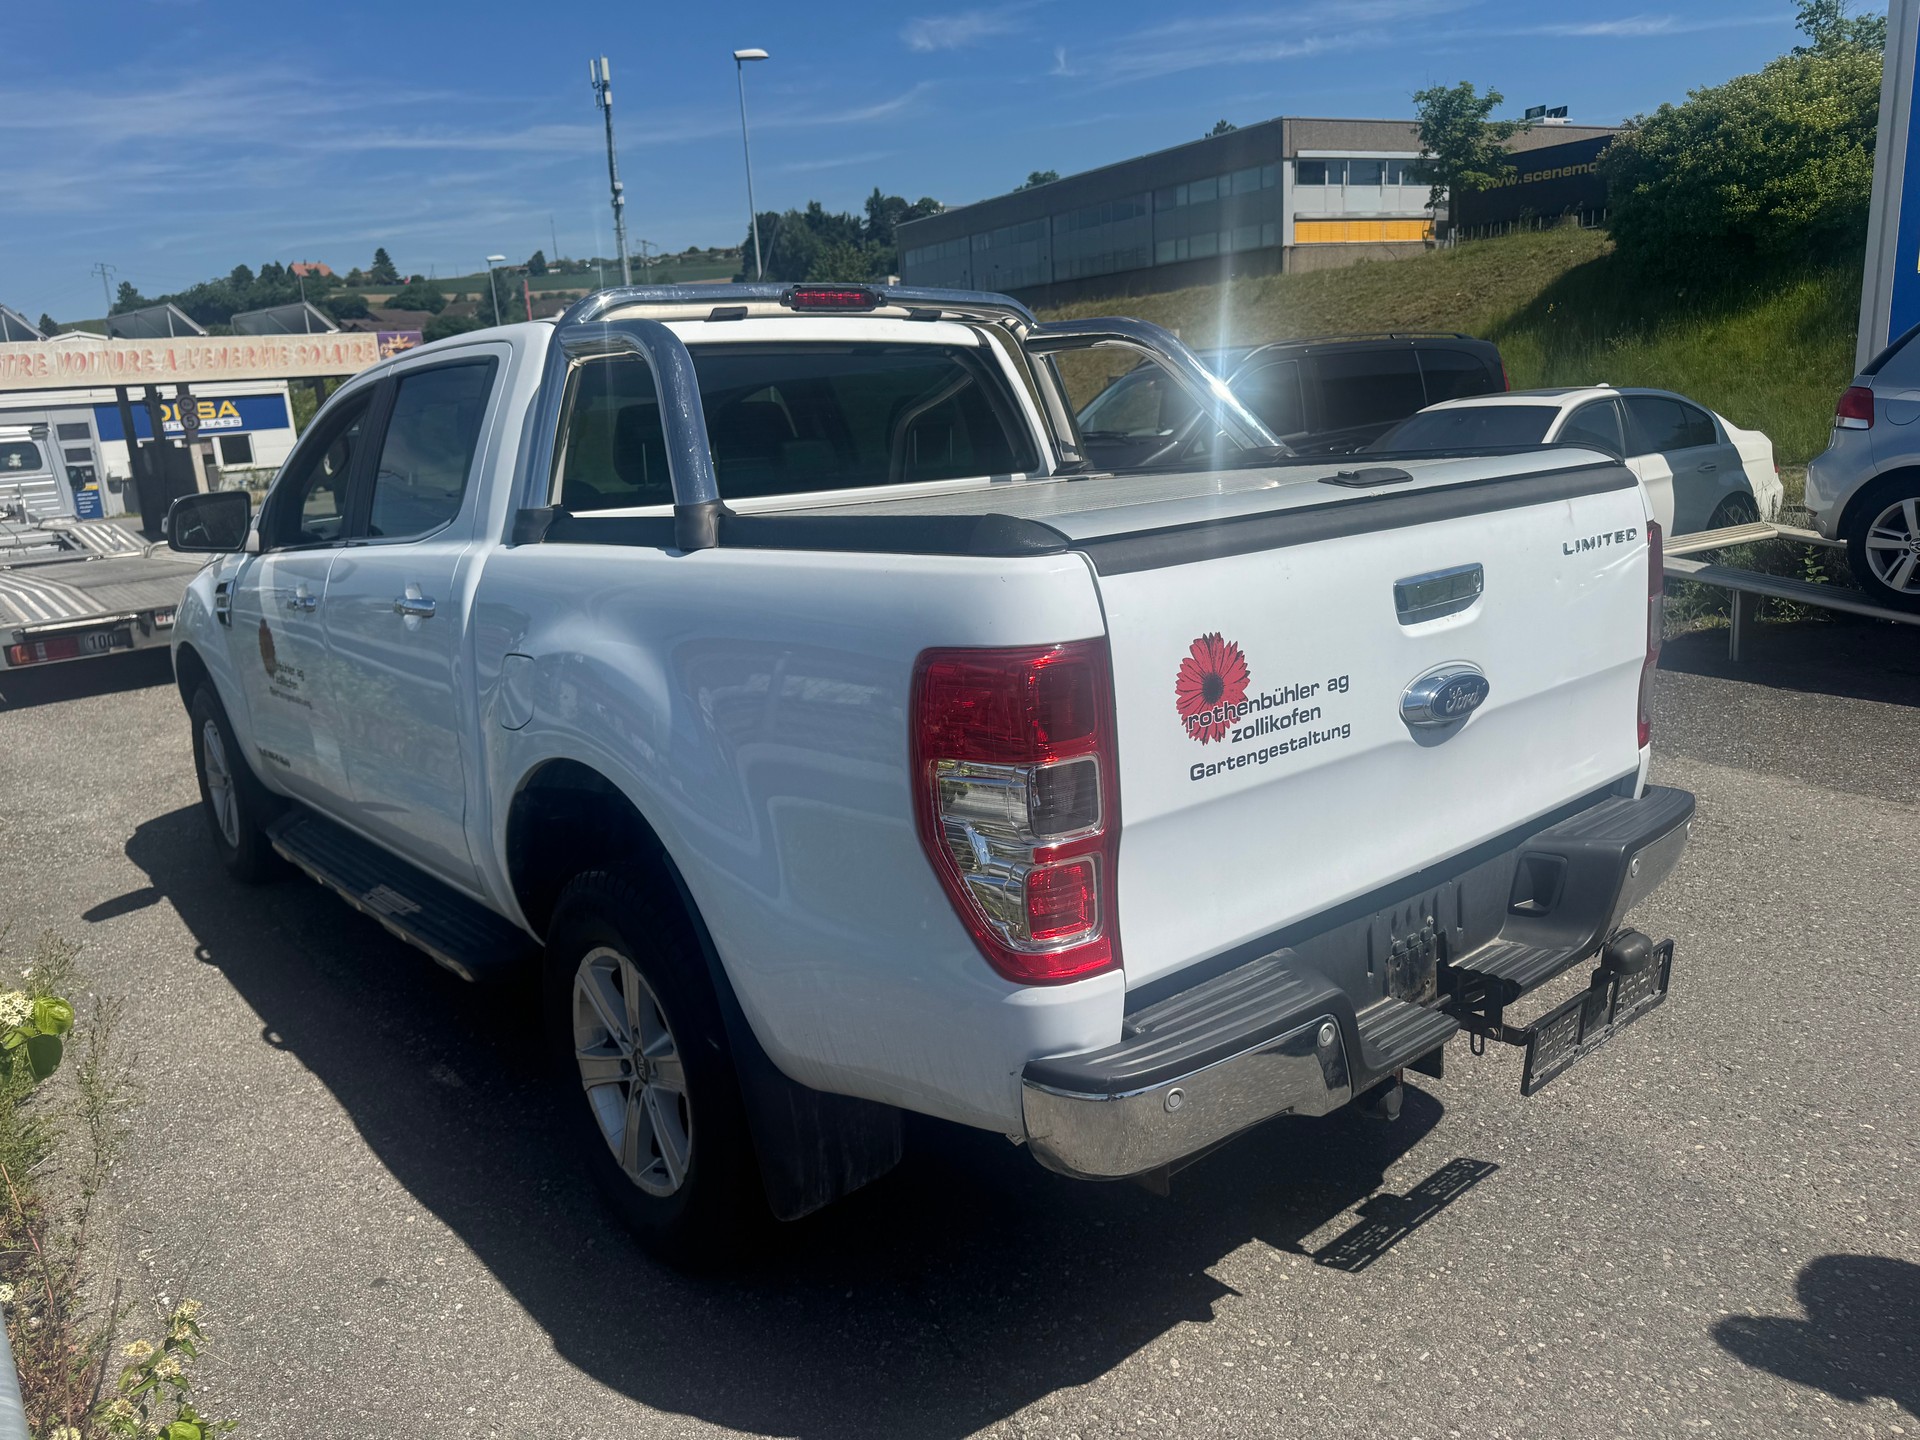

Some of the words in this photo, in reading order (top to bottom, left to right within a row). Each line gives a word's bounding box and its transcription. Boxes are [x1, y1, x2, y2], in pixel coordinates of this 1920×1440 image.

[0, 353, 48, 378] TRE
[55, 350, 154, 377] VOITURE
[295, 342, 375, 366] SOLAIRE
[1562, 527, 1638, 556] LIMITED
[89, 635, 116, 649] 100
[1188, 682, 1320, 730] rothenbühler
[1327, 674, 1349, 694] ag
[1445, 685, 1480, 713] Ford
[1231, 706, 1321, 743] zollikofen
[1190, 722, 1351, 781] Gartengestaltung
